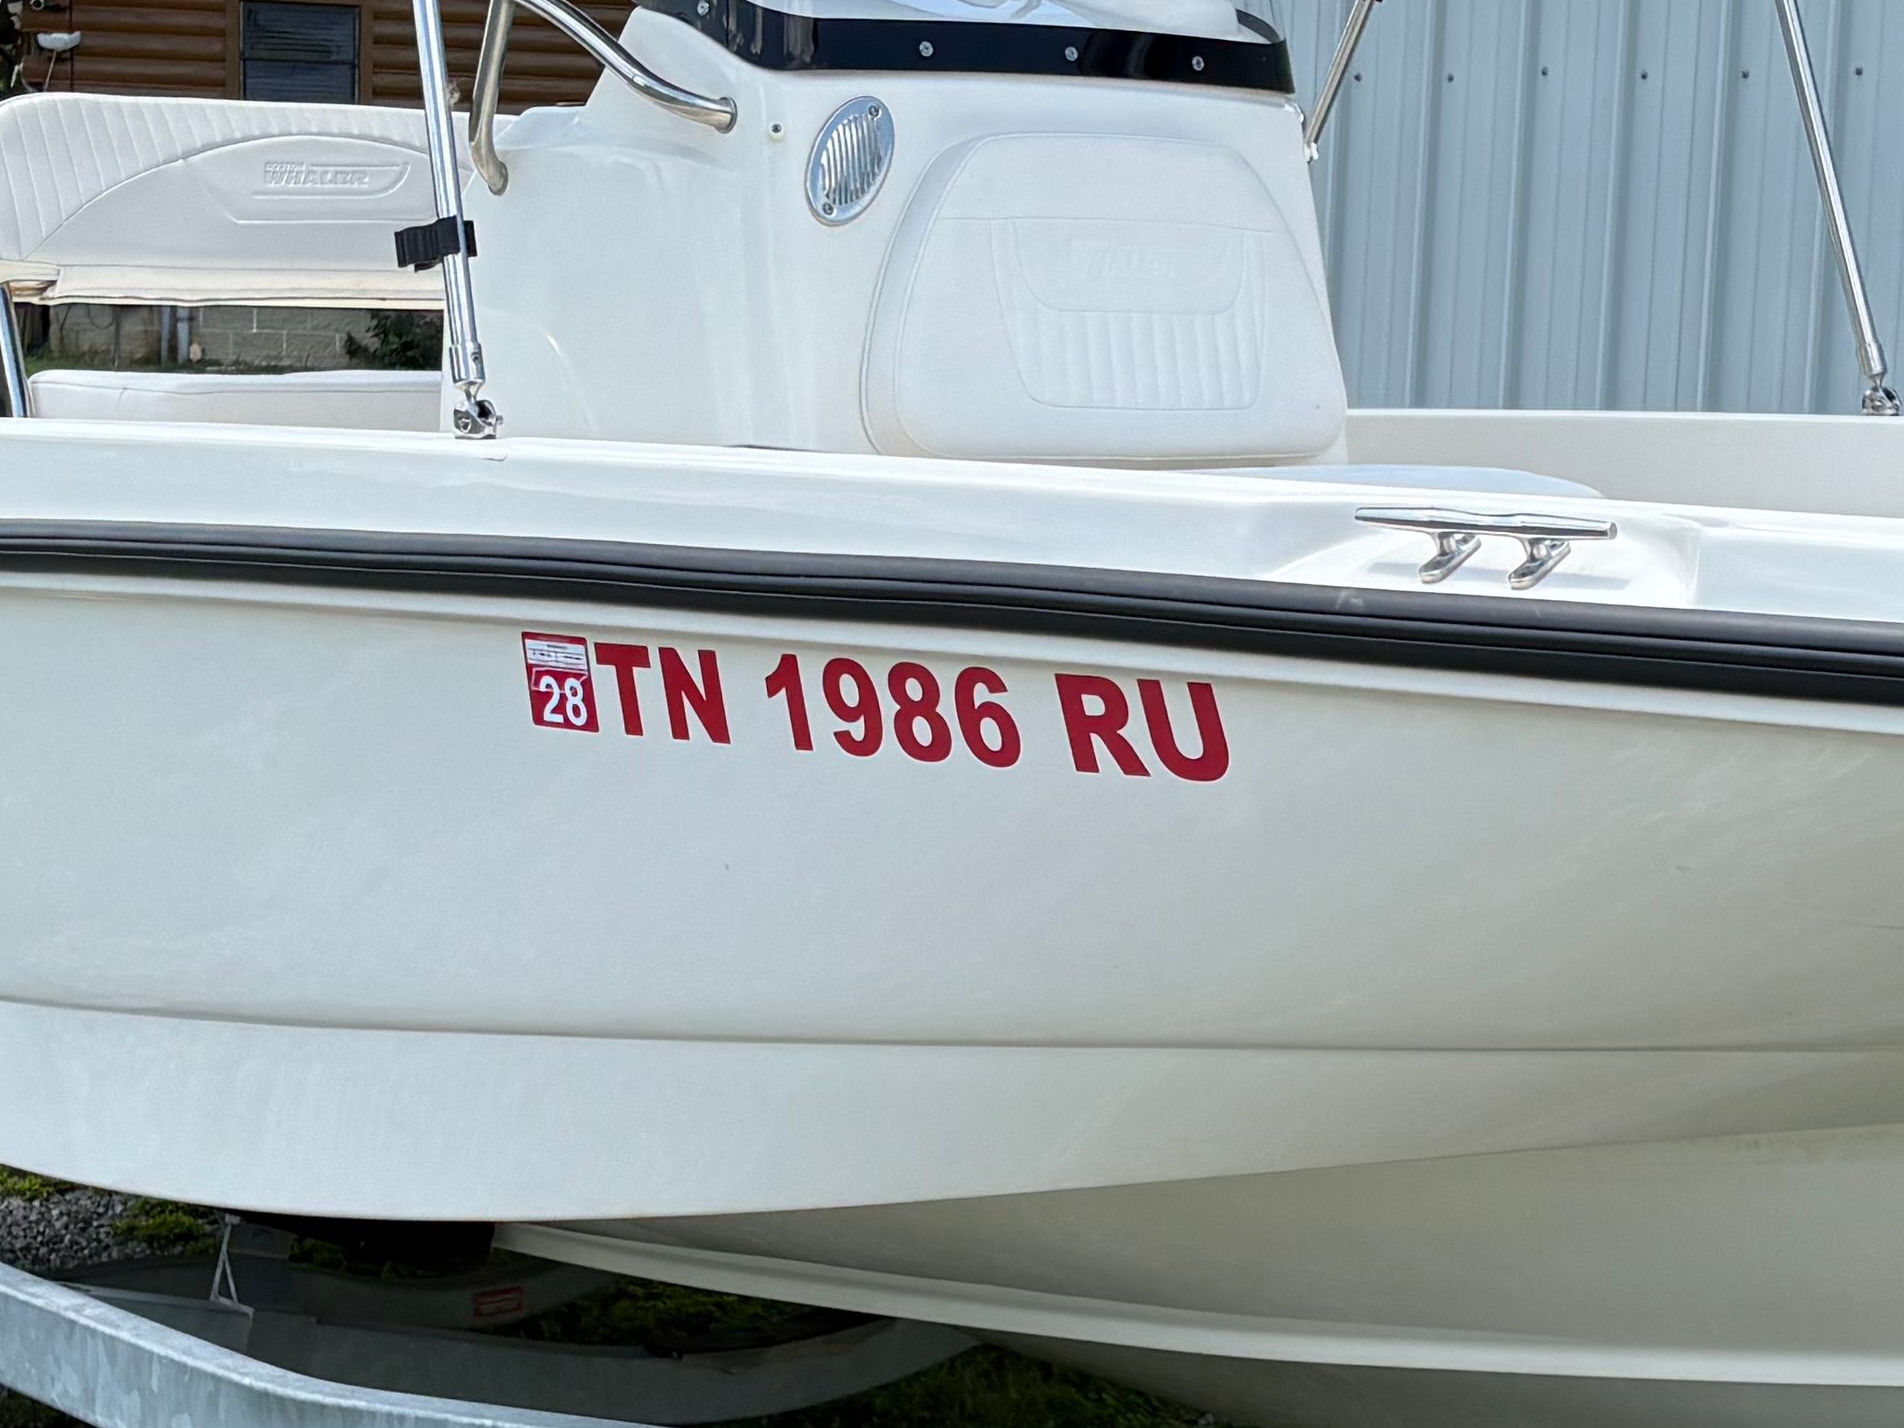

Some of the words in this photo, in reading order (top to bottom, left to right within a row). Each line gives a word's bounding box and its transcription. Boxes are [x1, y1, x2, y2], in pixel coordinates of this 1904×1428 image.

[539, 675, 588, 726] 28
[594, 642, 731, 744] TN
[765, 653, 1022, 768] 1986
[1054, 673, 1230, 783] RU
